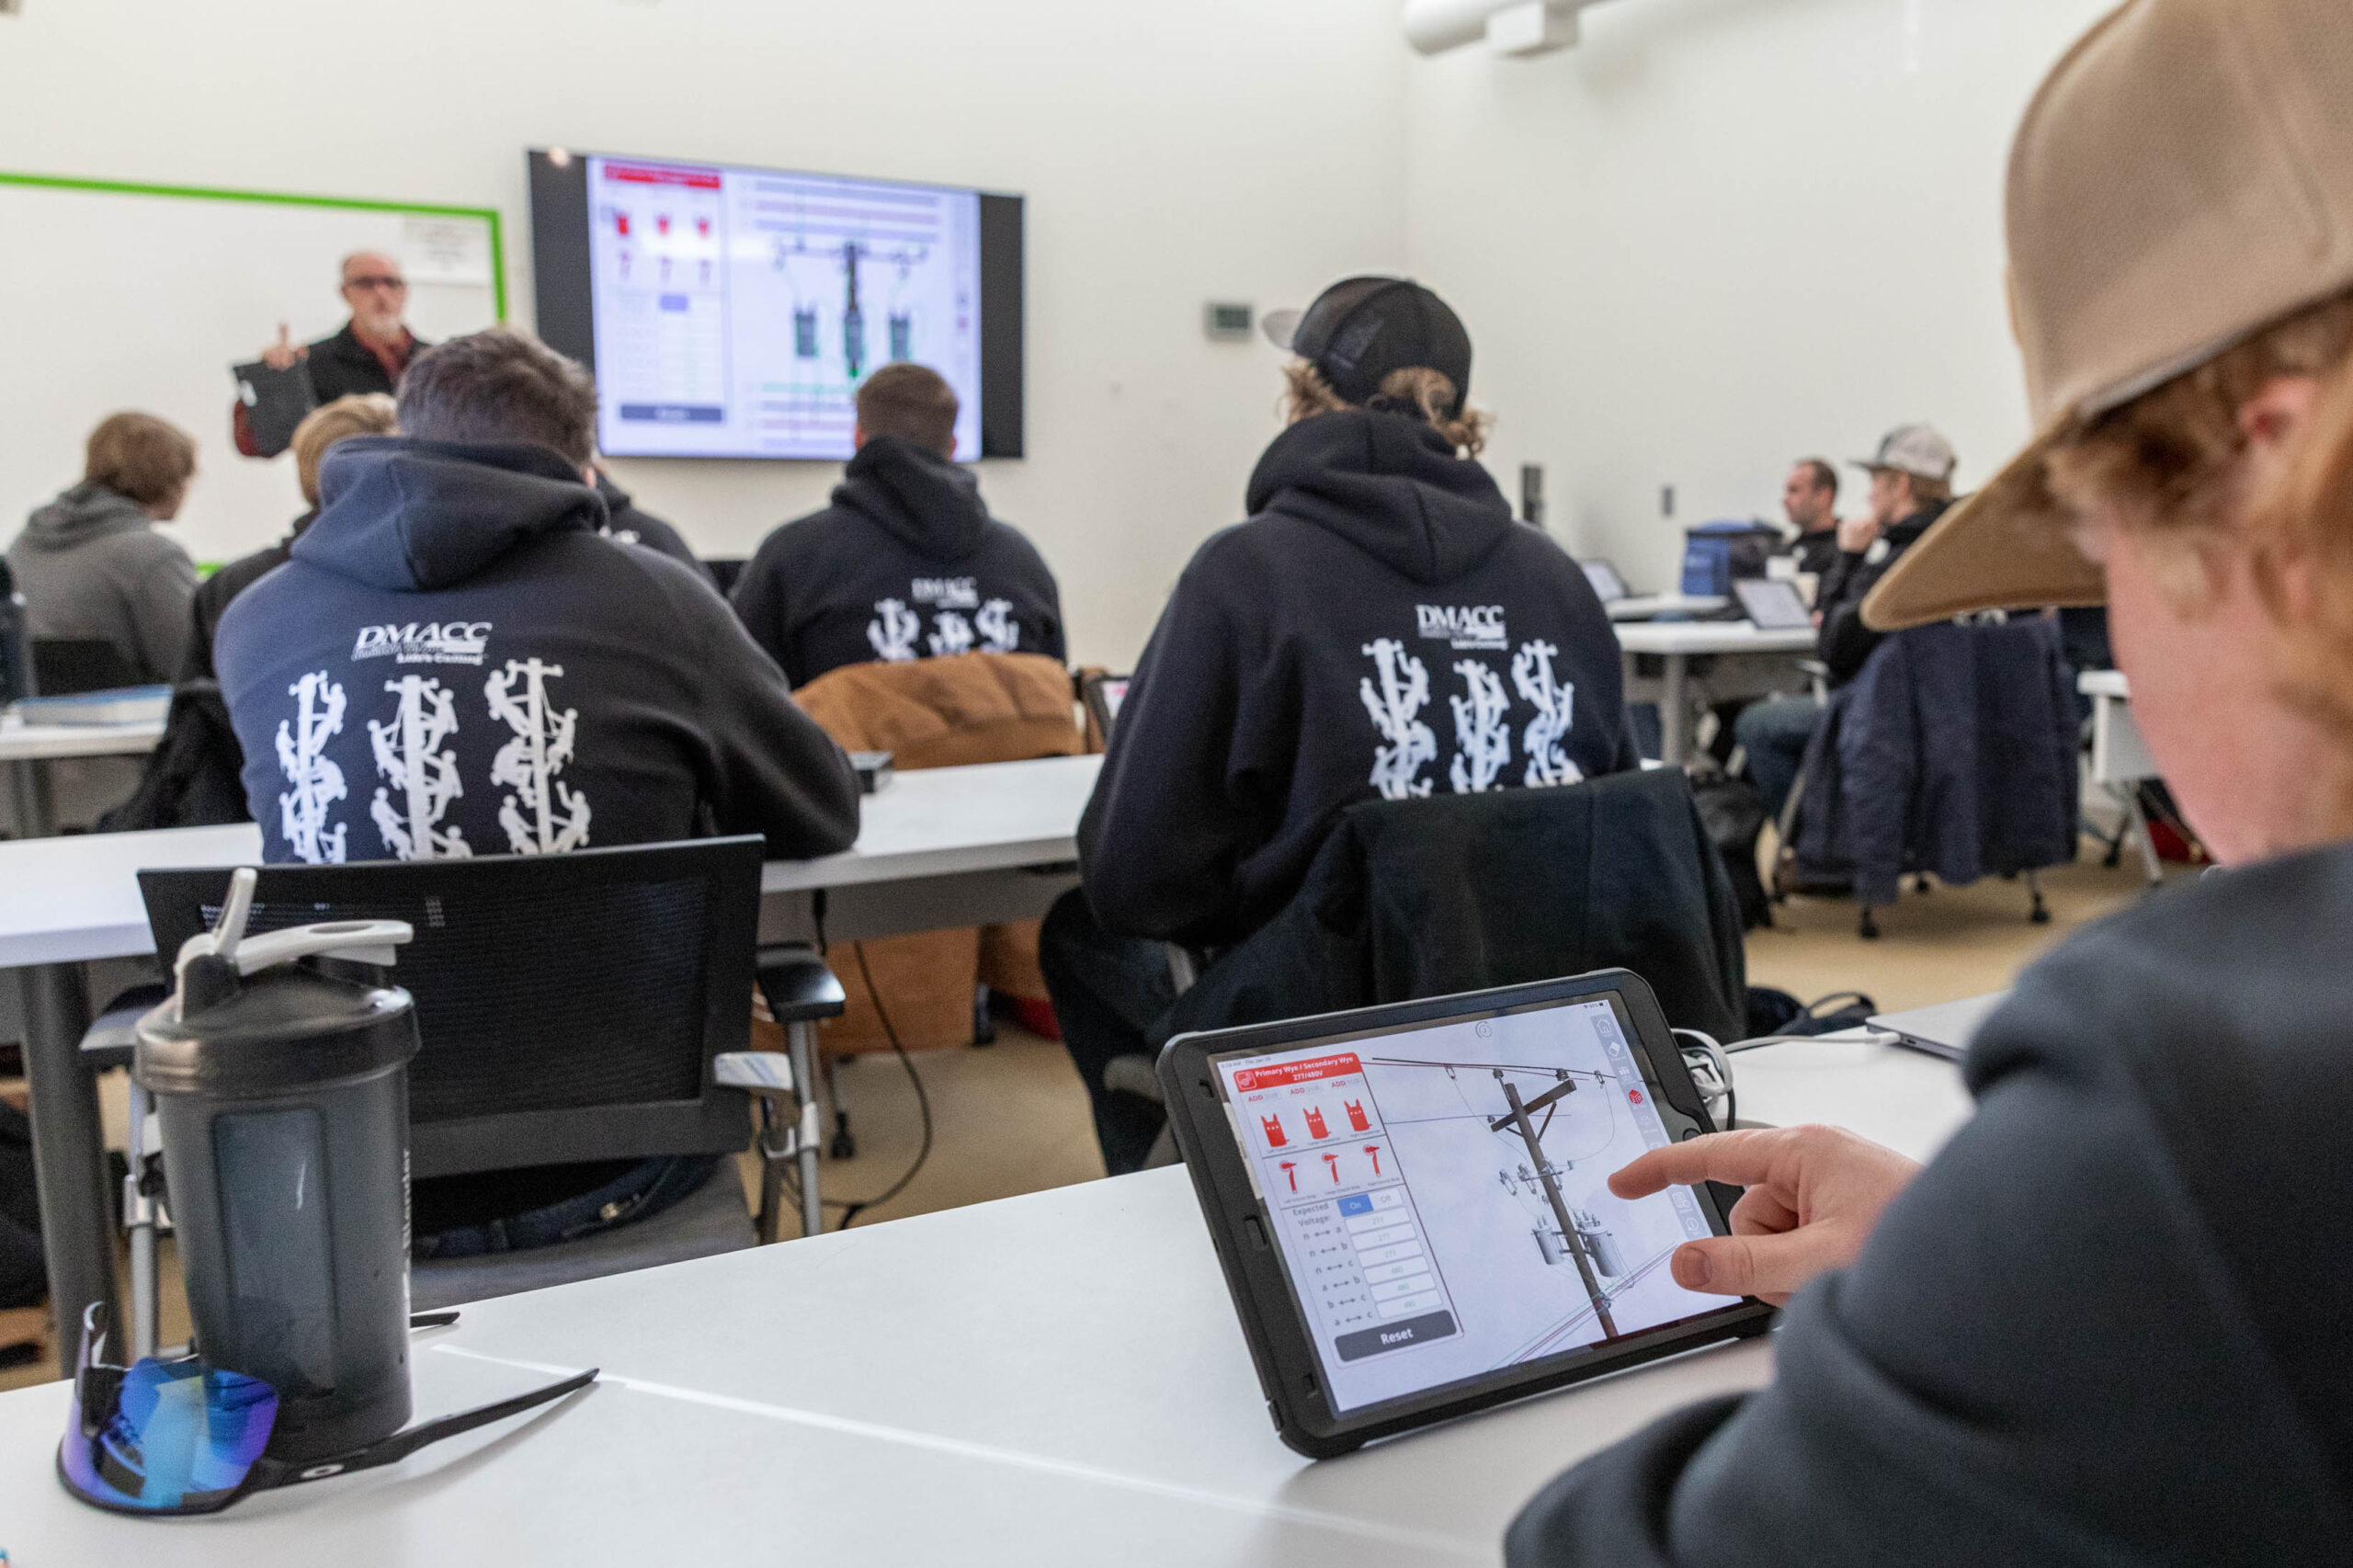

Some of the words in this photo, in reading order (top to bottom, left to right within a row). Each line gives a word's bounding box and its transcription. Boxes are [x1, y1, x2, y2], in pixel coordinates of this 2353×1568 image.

[1415, 604, 1506, 629] DMACC
[355, 621, 493, 649] DMACC
[1255, 1068, 1282, 1077] Primary
[1302, 1059, 1338, 1069] Secondary
[1292, 1202, 1329, 1216] Expected
[1349, 1202, 1362, 1210] On
[1380, 1328, 1414, 1346] Reset
